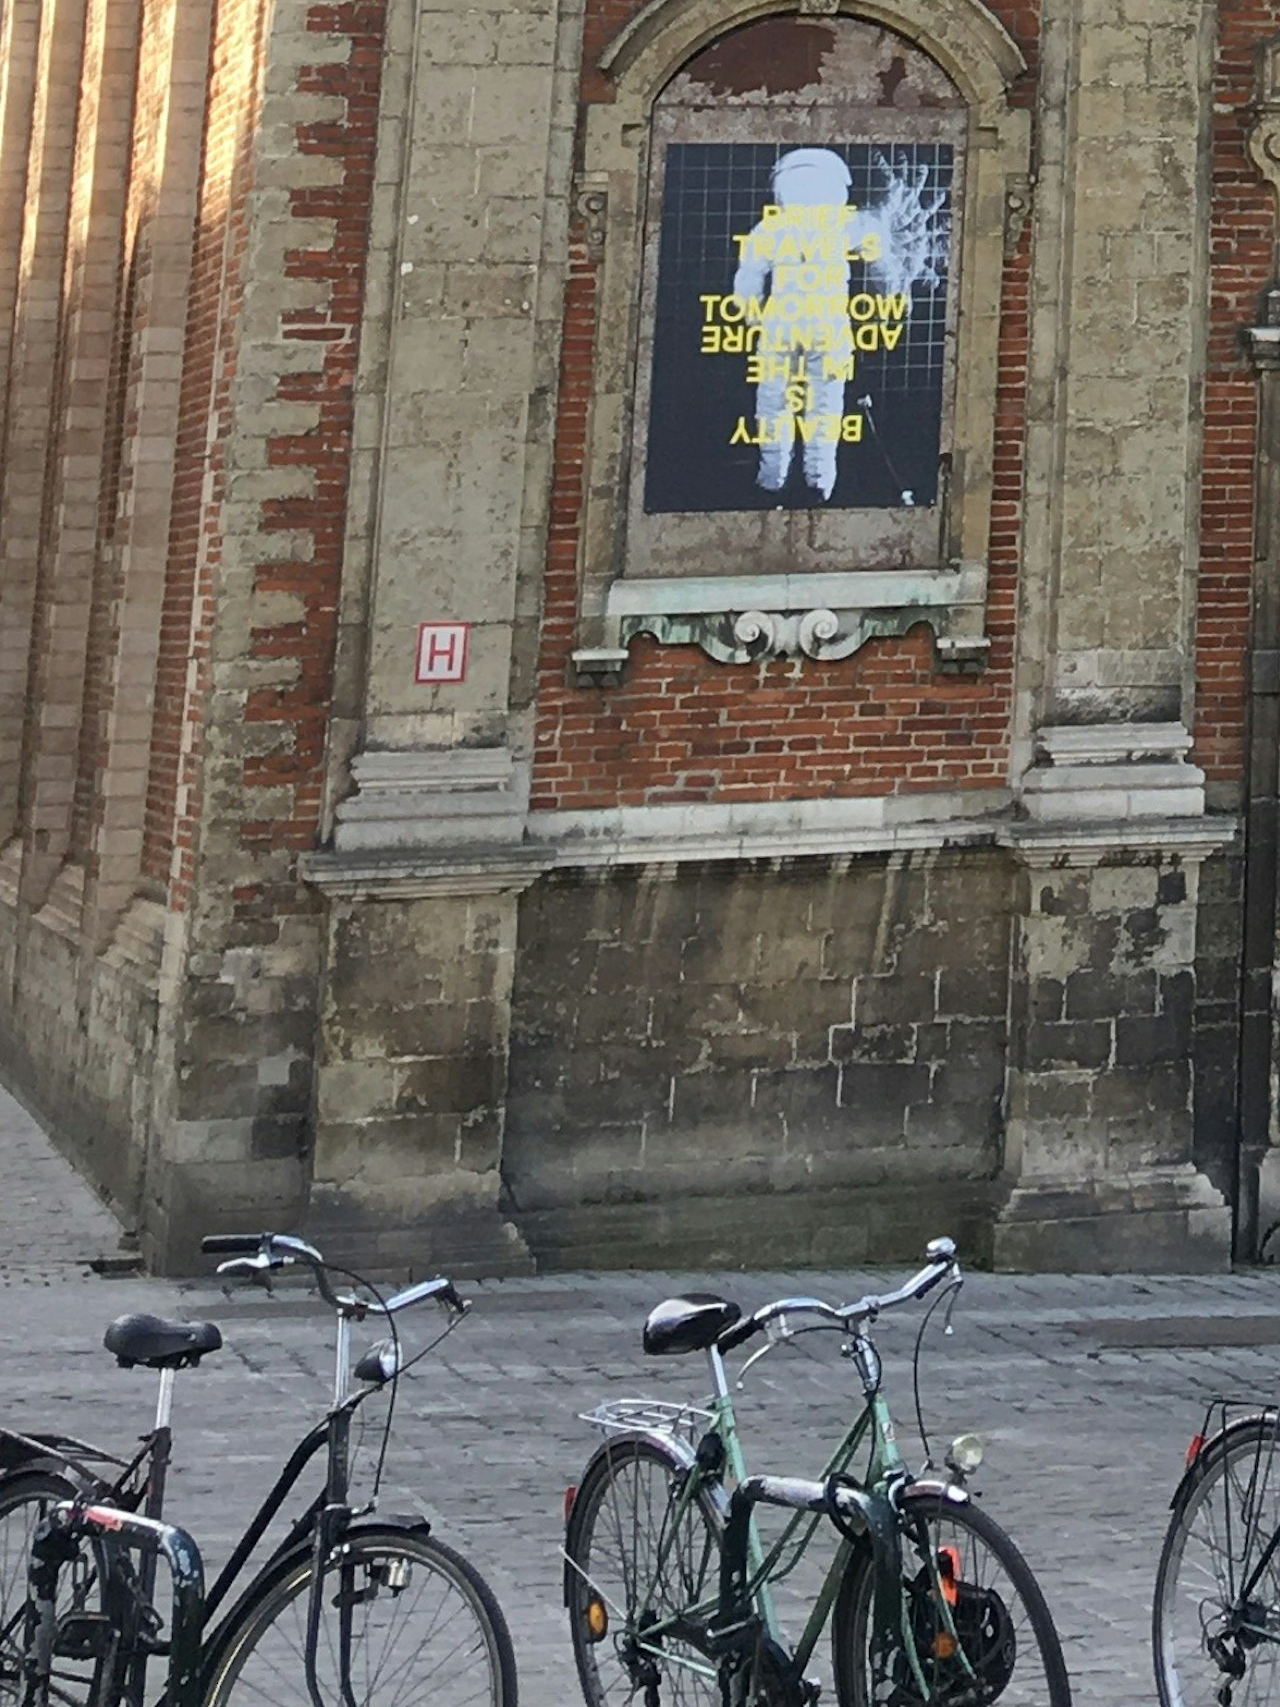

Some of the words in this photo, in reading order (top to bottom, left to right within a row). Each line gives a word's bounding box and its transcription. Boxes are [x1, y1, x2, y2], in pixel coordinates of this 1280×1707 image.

[762, 203, 858, 232] BRIEF
[732, 232, 881, 262] TRAVELS
[774, 263, 846, 291] FOR
[699, 293, 909, 322] TOMORROW
[700, 323, 904, 353] ADVENTURE
[746, 355, 810, 383] THE
[821, 353, 856, 382] IN
[784, 384, 815, 413] IS
[729, 414, 864, 444] BEAUTY
[428, 633, 456, 672] H
